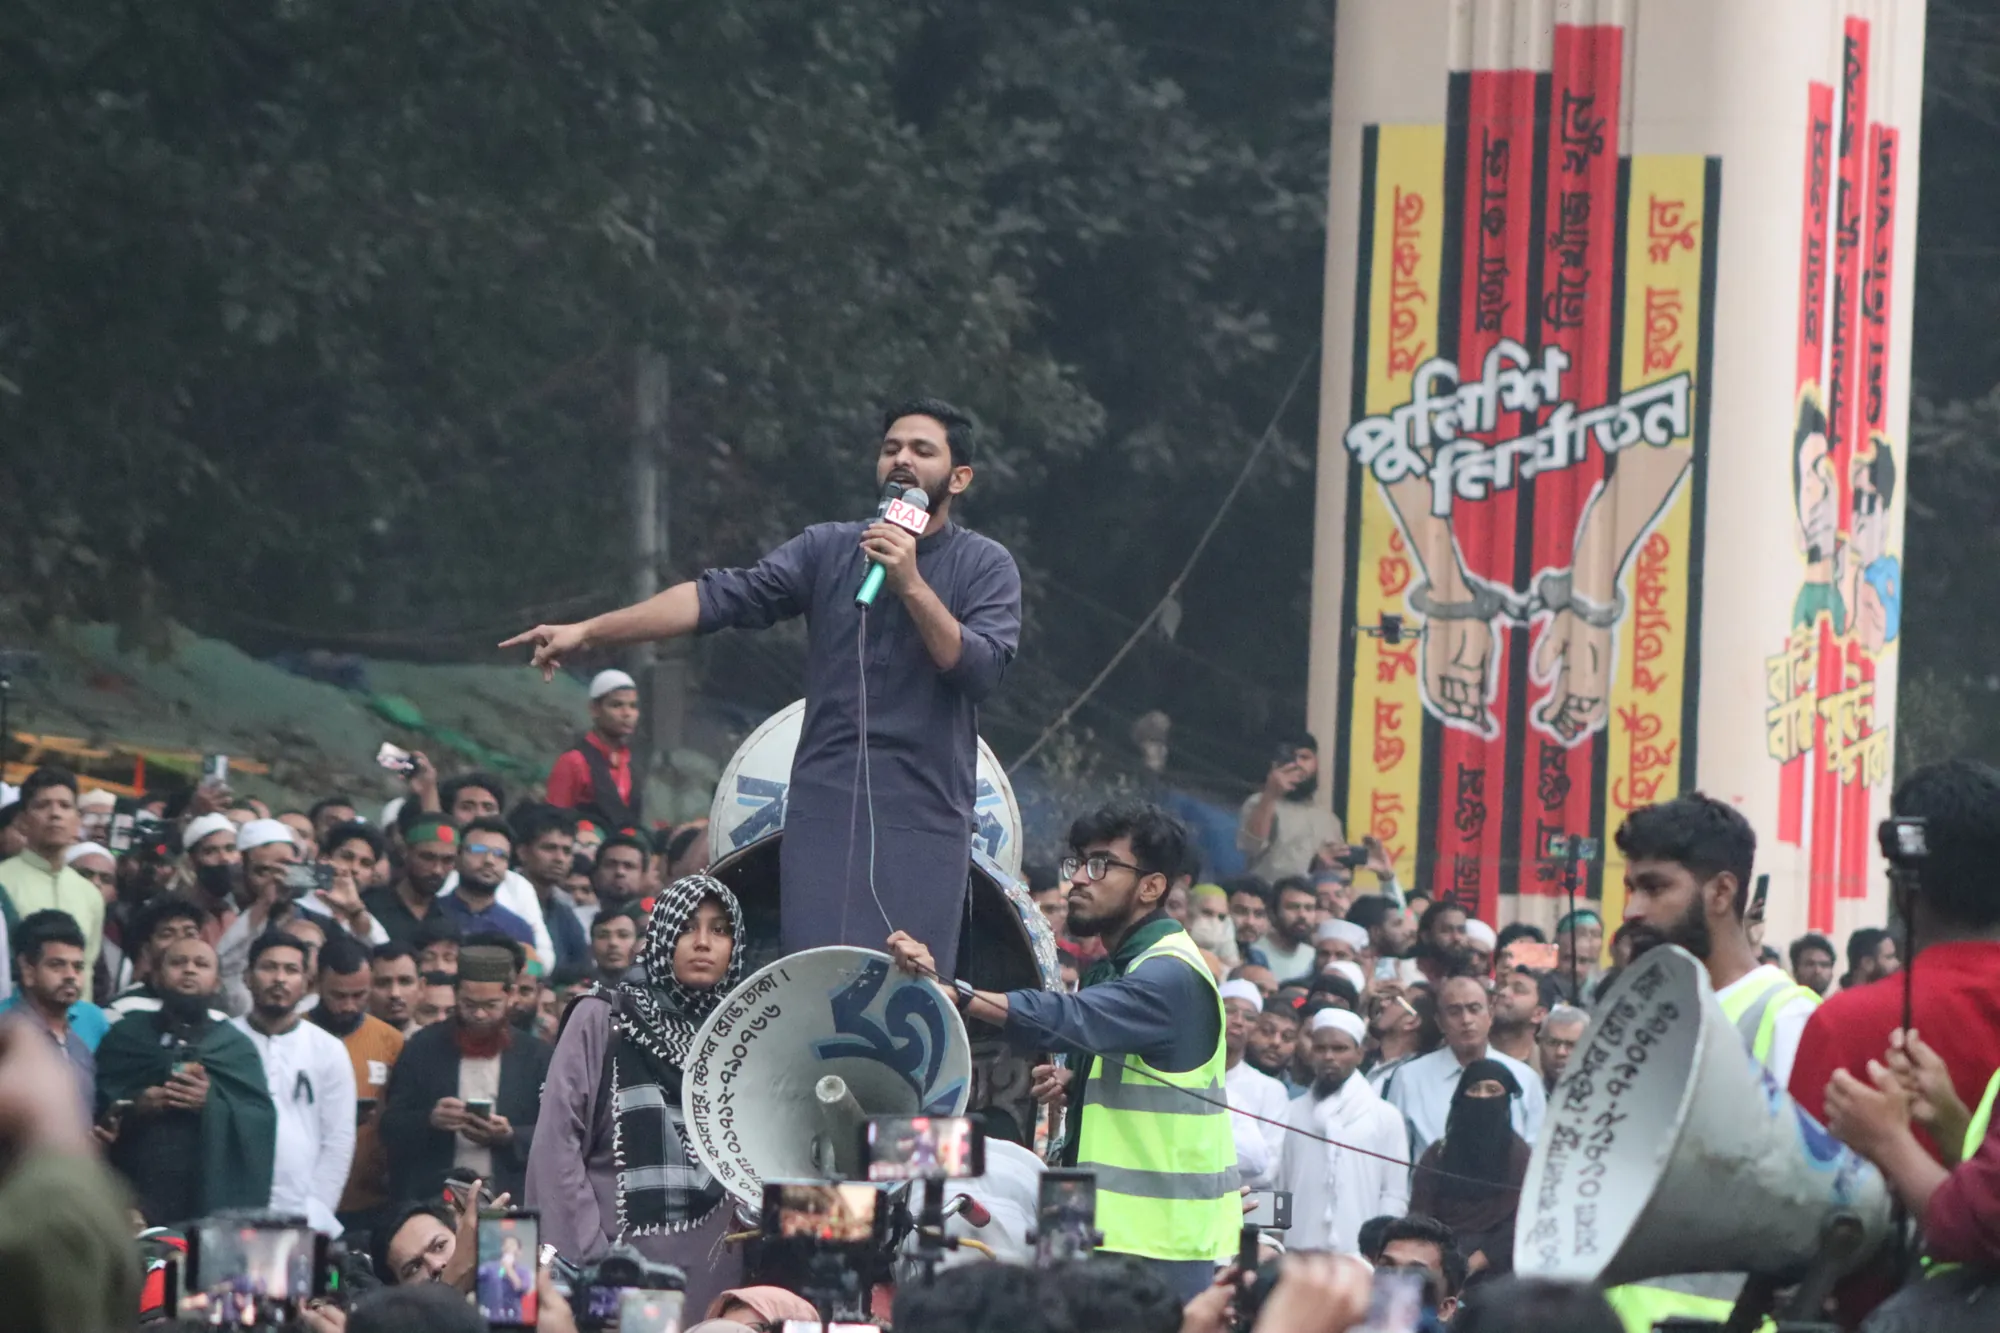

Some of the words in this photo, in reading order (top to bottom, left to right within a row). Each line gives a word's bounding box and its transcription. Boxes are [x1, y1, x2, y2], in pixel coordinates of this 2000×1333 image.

[1560, 90, 1604, 175] খুন
[1649, 196, 1698, 265] খুন
[1644, 287, 1684, 375] হত্যা
[888, 501, 928, 529] RAJ
[1377, 610, 1416, 683] খু
[738, 971, 779, 1006] ঢাকা
[717, 1002, 782, 1154] ০১৭১২-৭৯০৭৬৬
